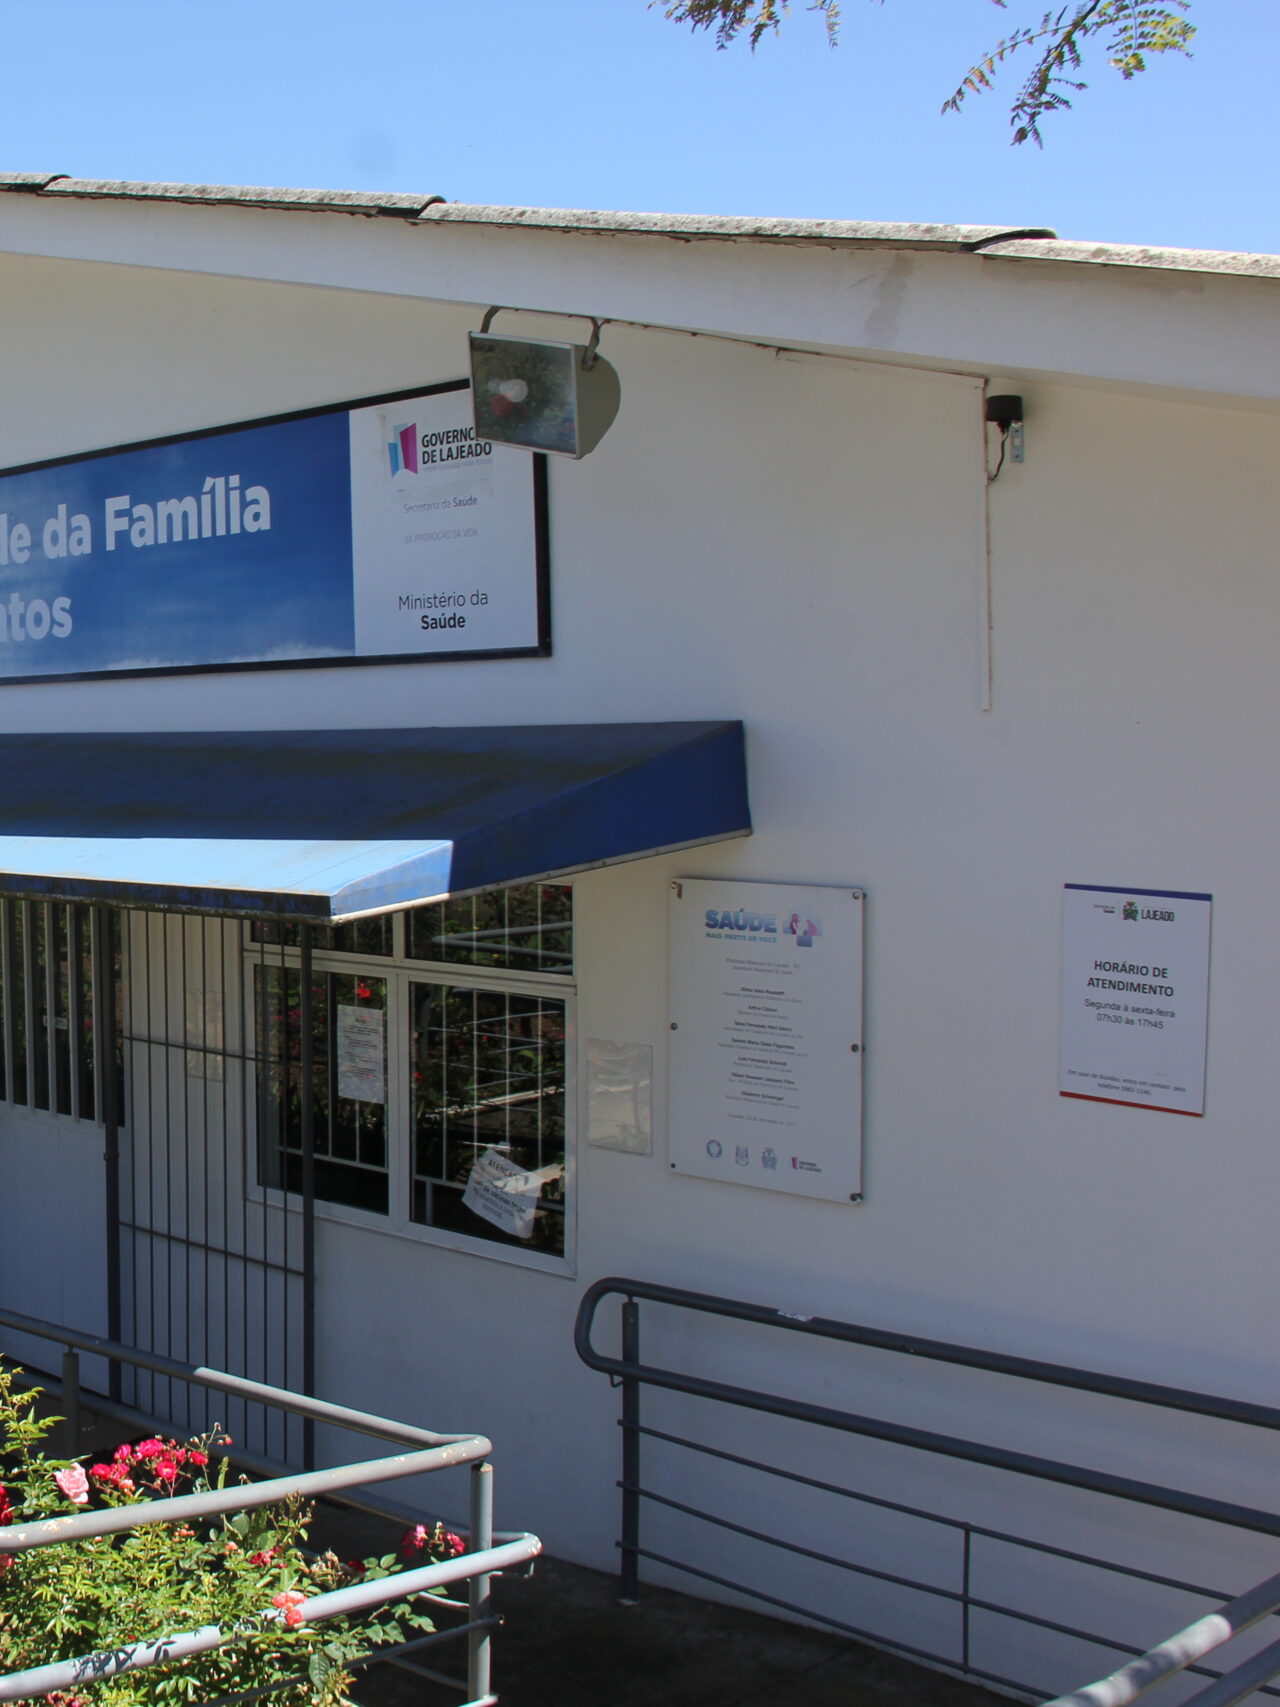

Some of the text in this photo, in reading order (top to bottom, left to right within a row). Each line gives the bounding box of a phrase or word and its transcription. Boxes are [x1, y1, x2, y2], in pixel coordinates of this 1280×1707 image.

[422, 442, 492, 464] DE LAJEADO
[452, 495, 478, 507] Saúde
[42, 503, 92, 559] da
[104, 474, 271, 552] Família
[398, 589, 488, 610] Ministério da
[421, 612, 466, 630] Saúde
[705, 907, 777, 933] SAÚDE
[1141, 908, 1174, 922] LAJEADO
[1094, 960, 1168, 978] HORÁRIO DE
[1087, 977, 1174, 997] ATENDIMENTO
[1083, 998, 1121, 1010] Segunda
[1131, 1006, 1176, 1018] sexta-feira
[1096, 1013, 1123, 1024] 07h30
